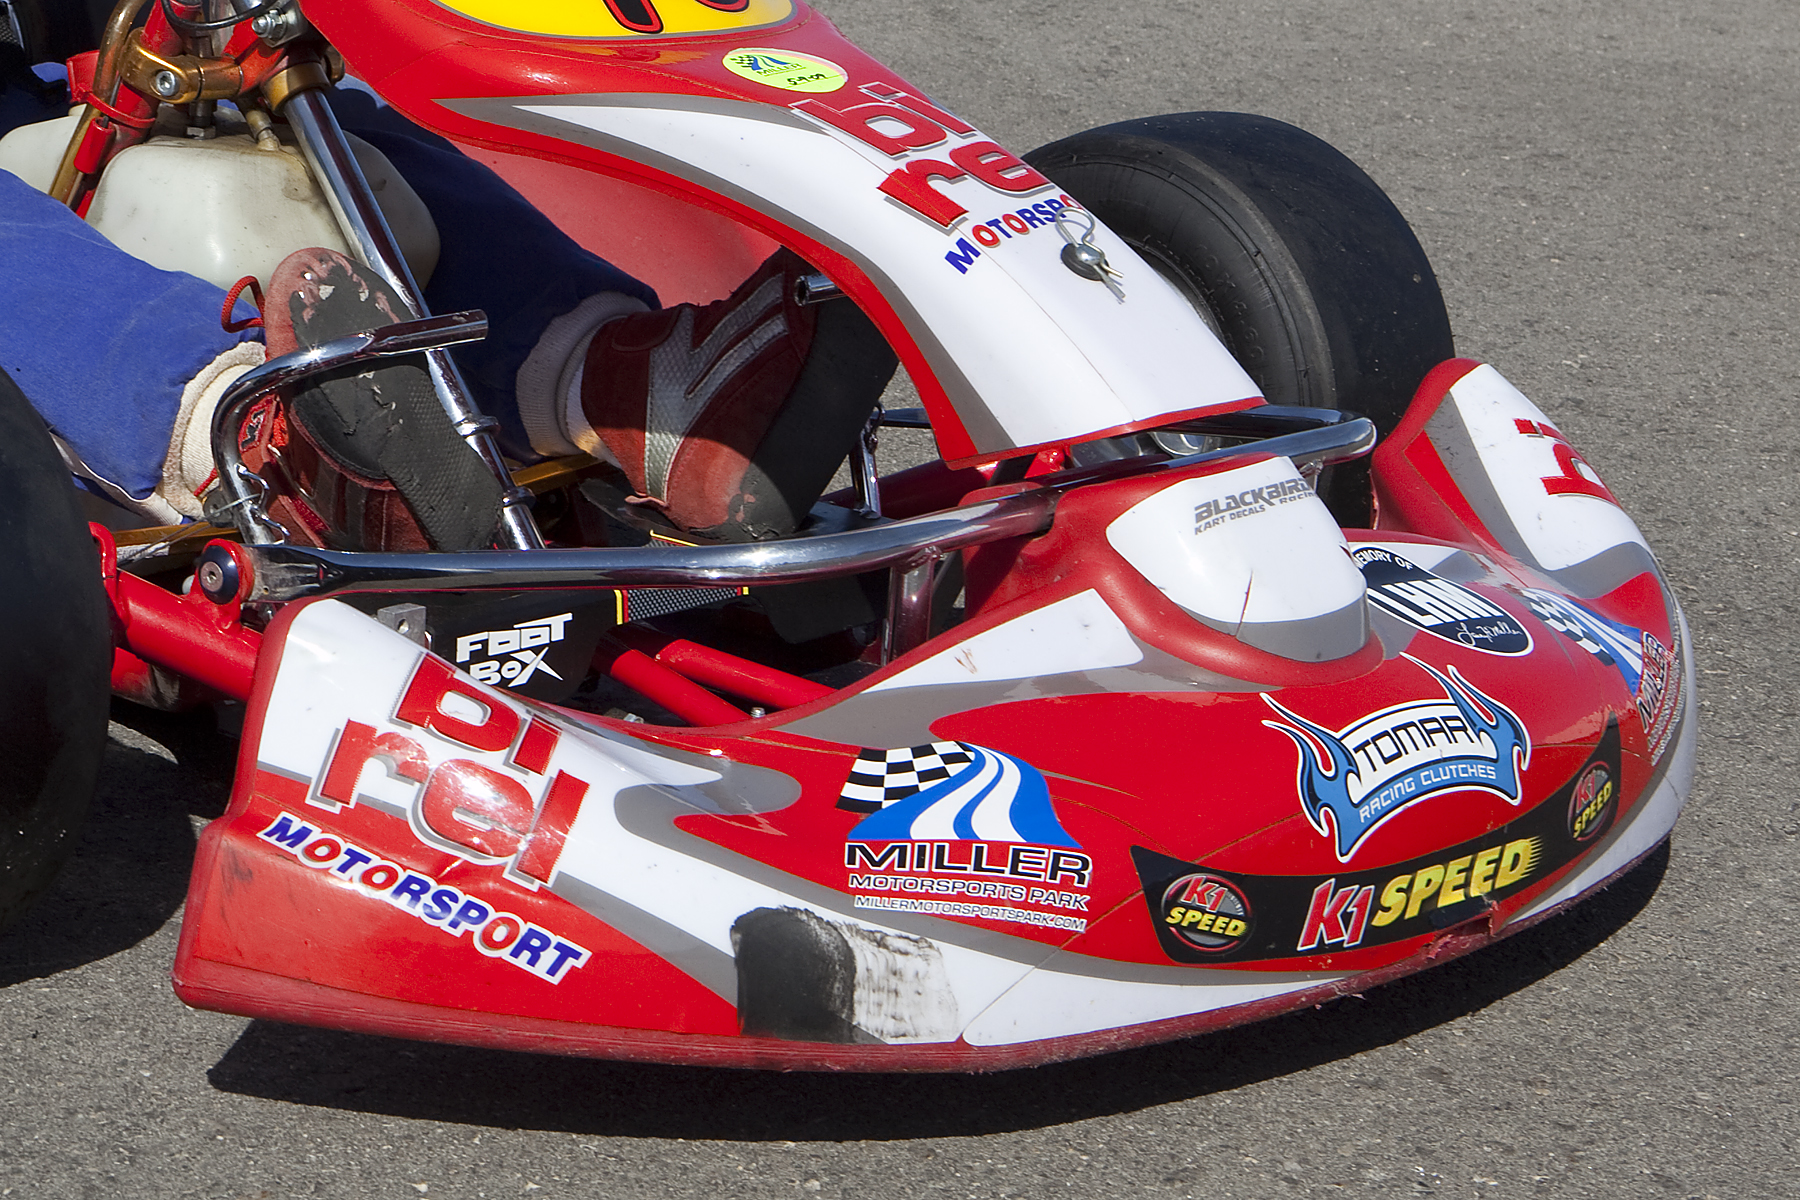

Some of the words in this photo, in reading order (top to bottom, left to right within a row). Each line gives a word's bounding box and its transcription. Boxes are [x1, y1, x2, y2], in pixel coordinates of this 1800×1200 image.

[1194, 477, 1311, 524] BLACKBIRD
[1194, 515, 1226, 536] KART
[1229, 504, 1266, 521] DECALS
[1279, 491, 1315, 505] Racin
[1394, 556, 1414, 570] OF
[1366, 578, 1504, 627] LHM
[456, 612, 573, 664] FOOT
[1352, 715, 1475, 773] TOMAR
[1358, 777, 1416, 824] RACING
[1419, 763, 1497, 786] CLUTCHES
[1572, 781, 1613, 839] SPEED
[845, 842, 1092, 888] MILLER
[261, 814, 584, 978] MOTORSPORT
[848, 873, 1026, 901] MOTORSPORTS
[1028, 889, 1091, 912] PARK
[853, 895, 1087, 934] MILLERMOTORSPORTSPARK.COM
[1180, 875, 1229, 913] K1
[1296, 878, 1375, 951] K1
[1370, 837, 1541, 927] SPEED
[1165, 906, 1247, 937] SPEED
